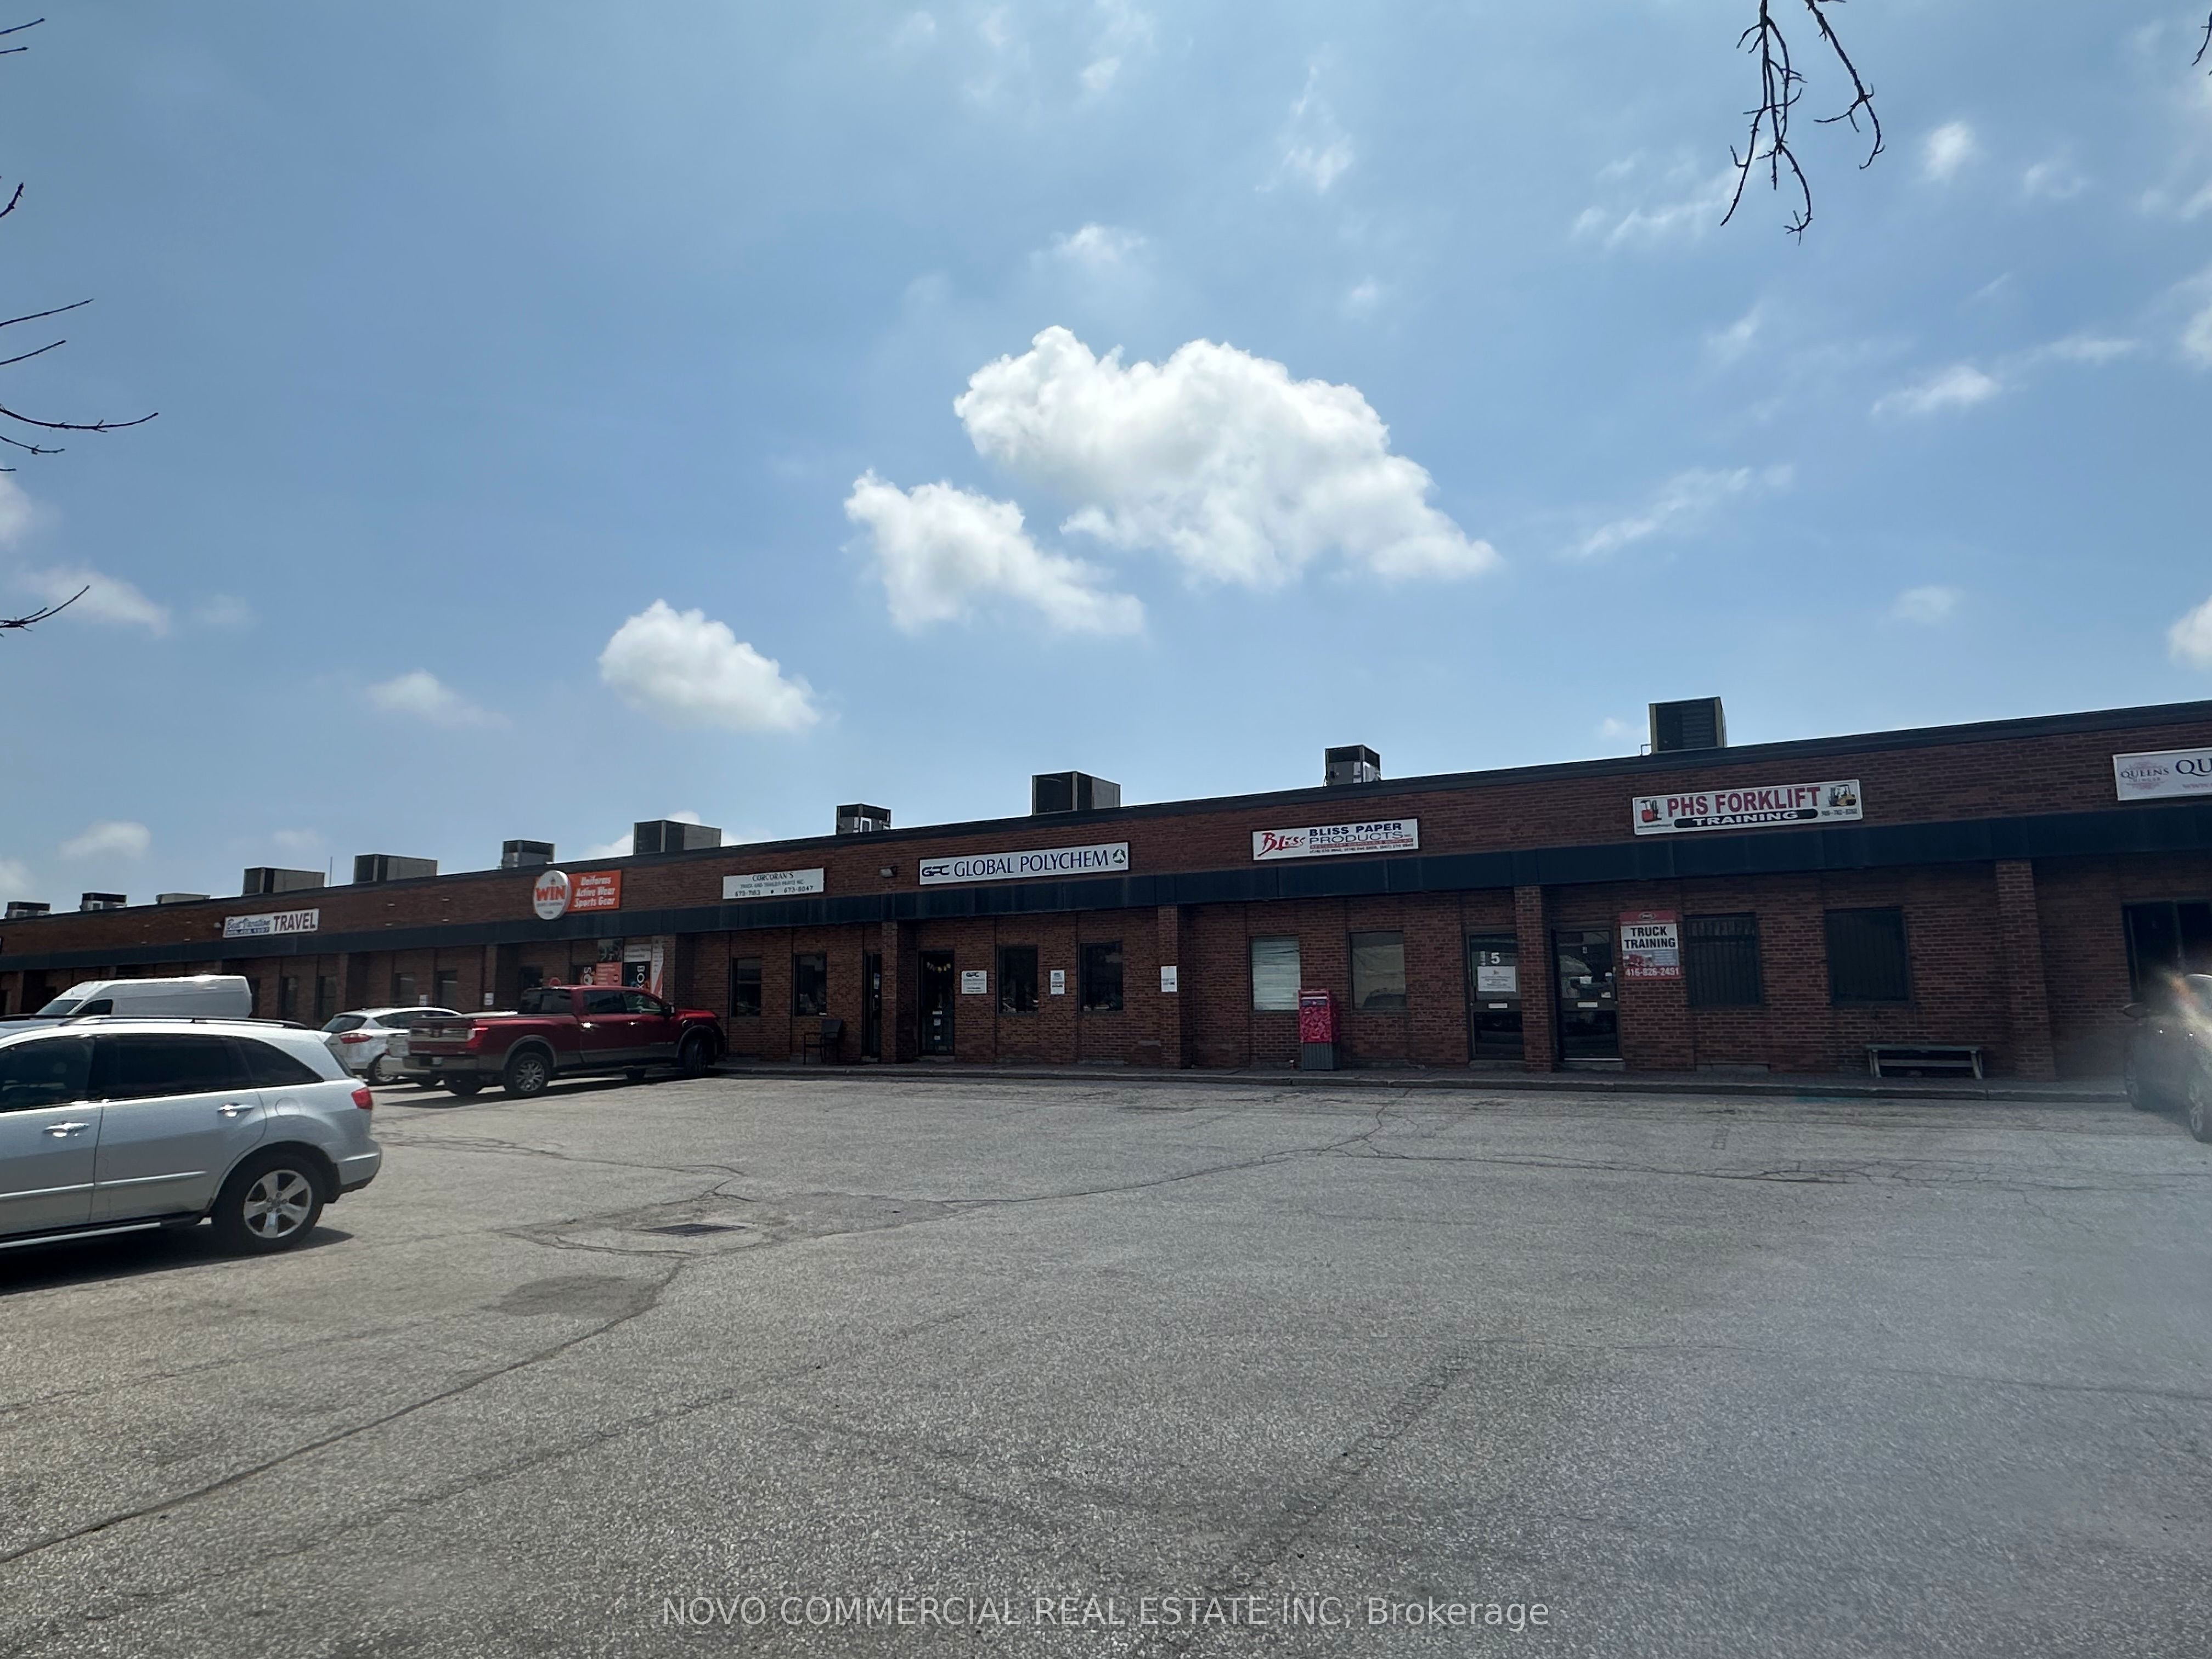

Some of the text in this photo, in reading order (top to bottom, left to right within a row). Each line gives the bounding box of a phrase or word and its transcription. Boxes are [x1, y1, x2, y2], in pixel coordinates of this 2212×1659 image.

[2120, 769, 2169, 778] QUEENS
[1667, 787, 1820, 817] PHS FORKLIFT
[1692, 811, 1798, 826] TRAINING
[1309, 823, 1402, 836] BLISS PAPER
[1309, 831, 1403, 845] PRODUCTS
[954, 858, 1014, 877] GLOBAL
[1020, 849, 1109, 872] POLYCHEM
[580, 875, 611, 886] Uniforms
[535, 885, 566, 901] WIN
[576, 886, 616, 897] Active Wear
[574, 898, 596, 908] Sports
[598, 896, 616, 906] Gear
[274, 912, 316, 932] TRAVEL
[1630, 926, 1667, 936] TRUCK
[1624, 938, 1675, 949] TRAINING
[1491, 952, 1500, 964] 5
